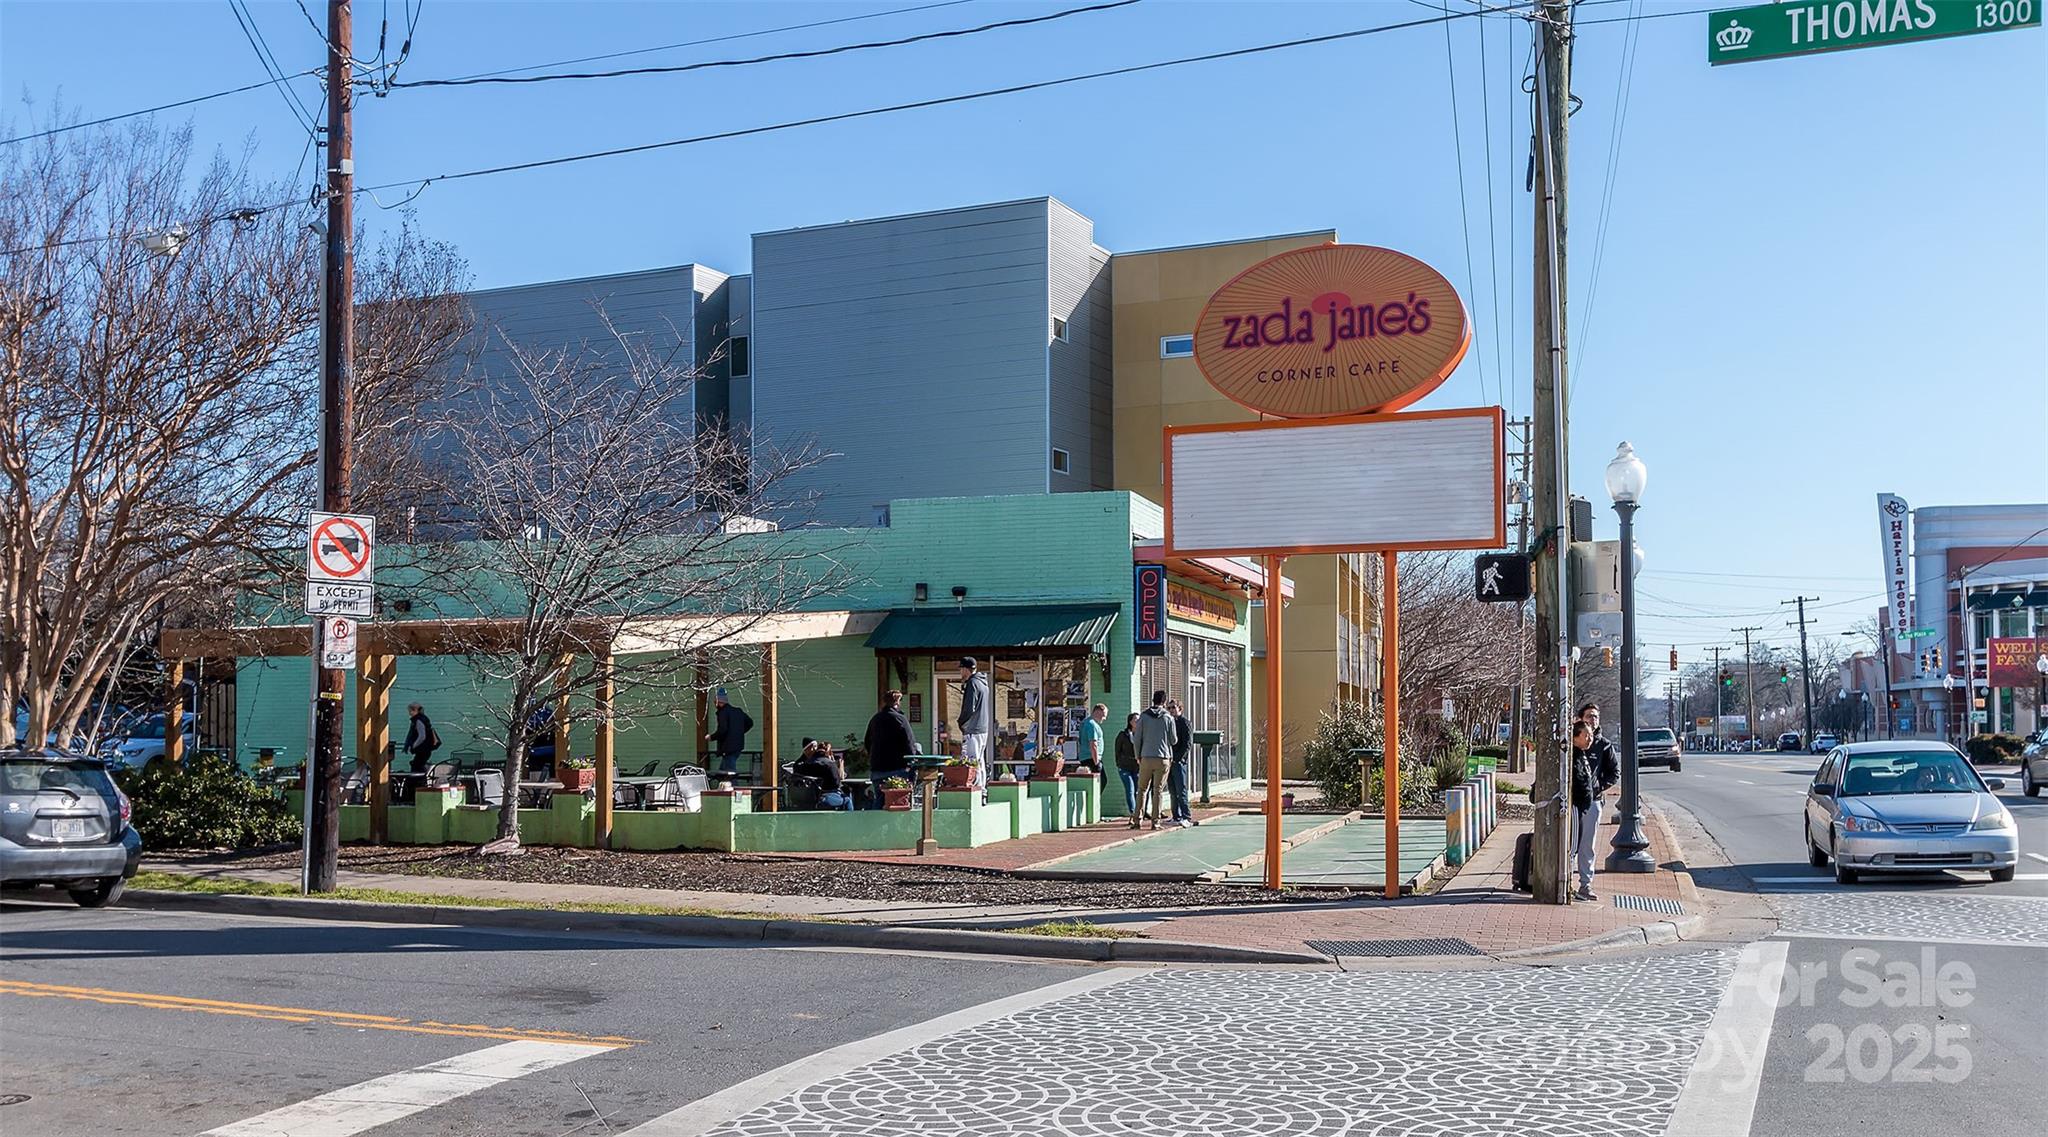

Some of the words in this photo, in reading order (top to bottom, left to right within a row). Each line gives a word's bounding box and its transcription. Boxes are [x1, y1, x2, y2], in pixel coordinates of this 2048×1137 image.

[1786, 0, 1936, 44] THOMAS
[1975, 0, 2031, 28] 1300
[1221, 296, 1314, 351] zada
[1322, 291, 1432, 353] jane's
[1257, 366, 1336, 384] CORNER
[1891, 520, 1904, 575] Harris
[316, 586, 364, 599] EXCEPT
[319, 599, 328, 609] BY
[333, 600, 359, 611] PERMIT
[1141, 570, 1158, 640] OPEN
